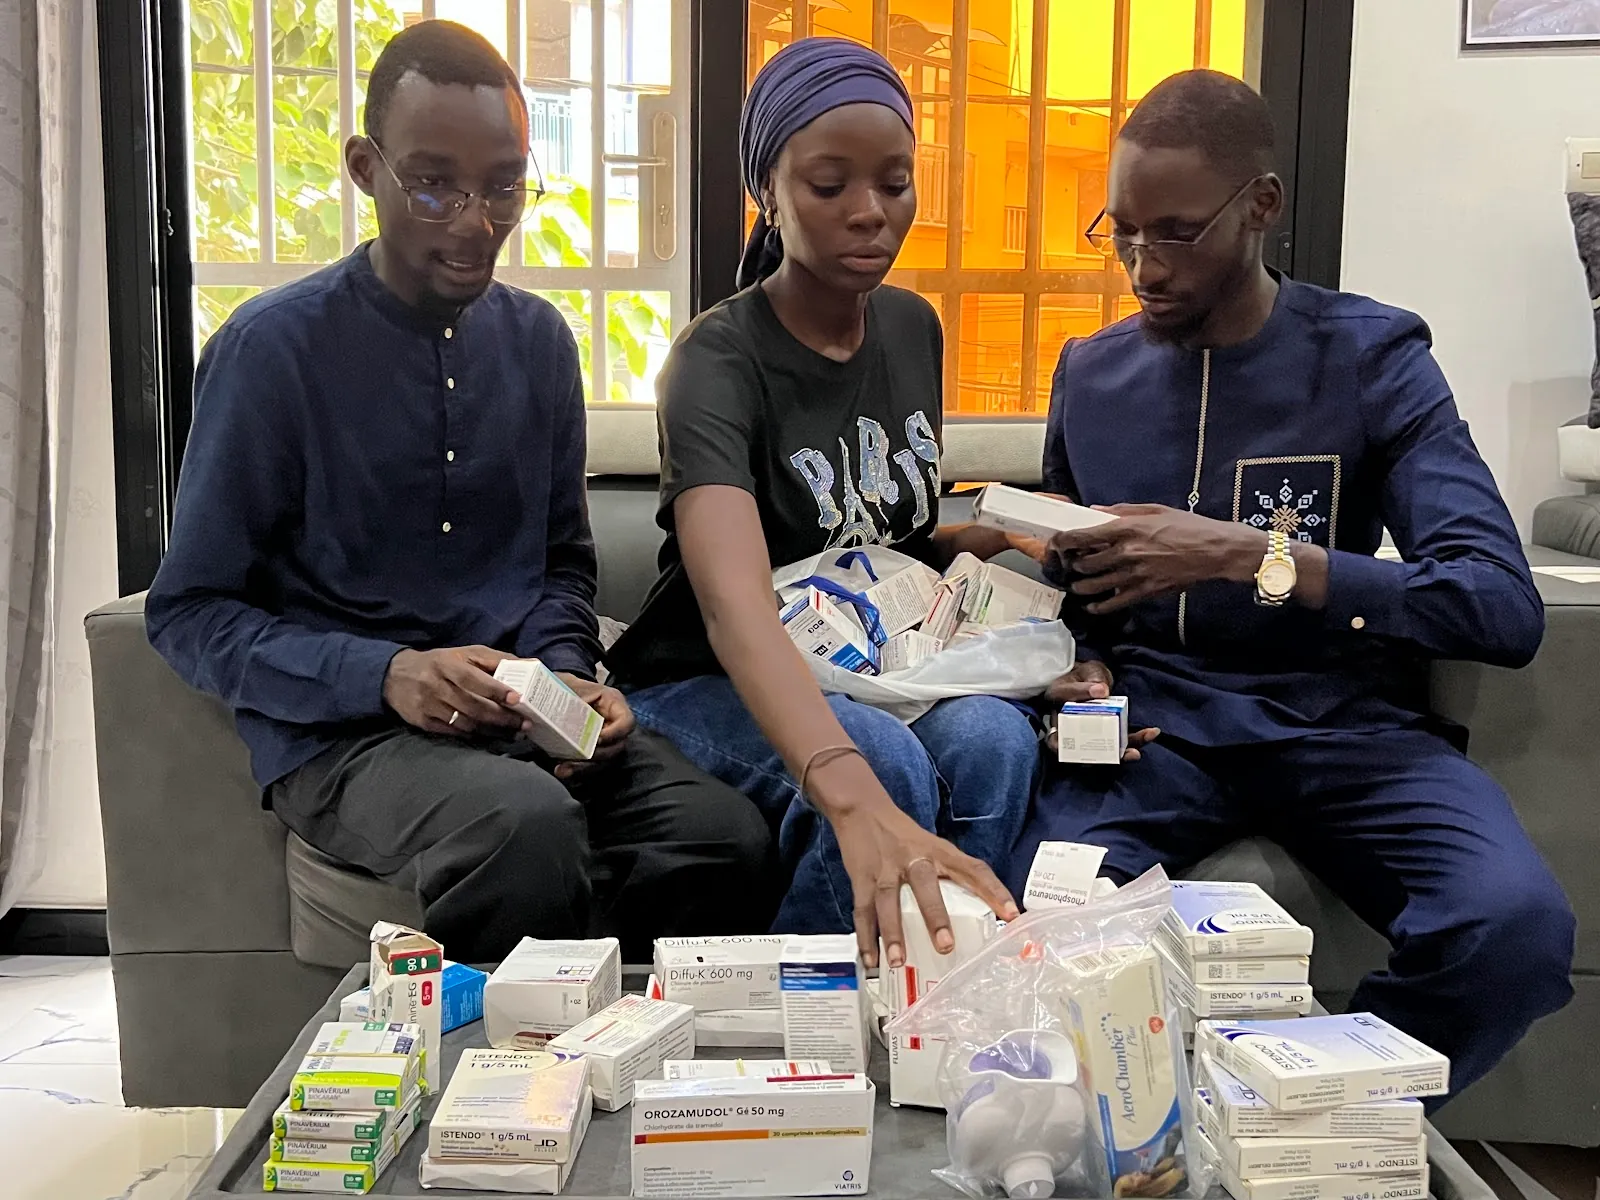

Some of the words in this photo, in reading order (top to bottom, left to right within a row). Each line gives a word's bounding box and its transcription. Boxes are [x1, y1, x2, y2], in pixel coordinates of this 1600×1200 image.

[407, 958, 417, 971] 90
[709, 968, 733, 979] 600
[736, 969, 753, 981] mg
[1256, 992, 1269, 1000] g/5
[1271, 991, 1284, 999] mL
[1112, 1027, 1134, 1123] AeroChamber
[308, 1087, 350, 1095] PINAVÉRIUM
[1366, 1090, 1379, 1098] mL
[1379, 1085, 1393, 1095] g/5
[736, 1106, 749, 1116] Gé
[751, 1106, 765, 1116] 50
[767, 1107, 785, 1118] mg
[490, 1132, 495, 1140] 1
[498, 1132, 514, 1142] g/5
[516, 1132, 532, 1141] mL
[1334, 1161, 1350, 1170] mL
[1350, 1160, 1364, 1169] g/5
[834, 1182, 861, 1190] VIATRIS
